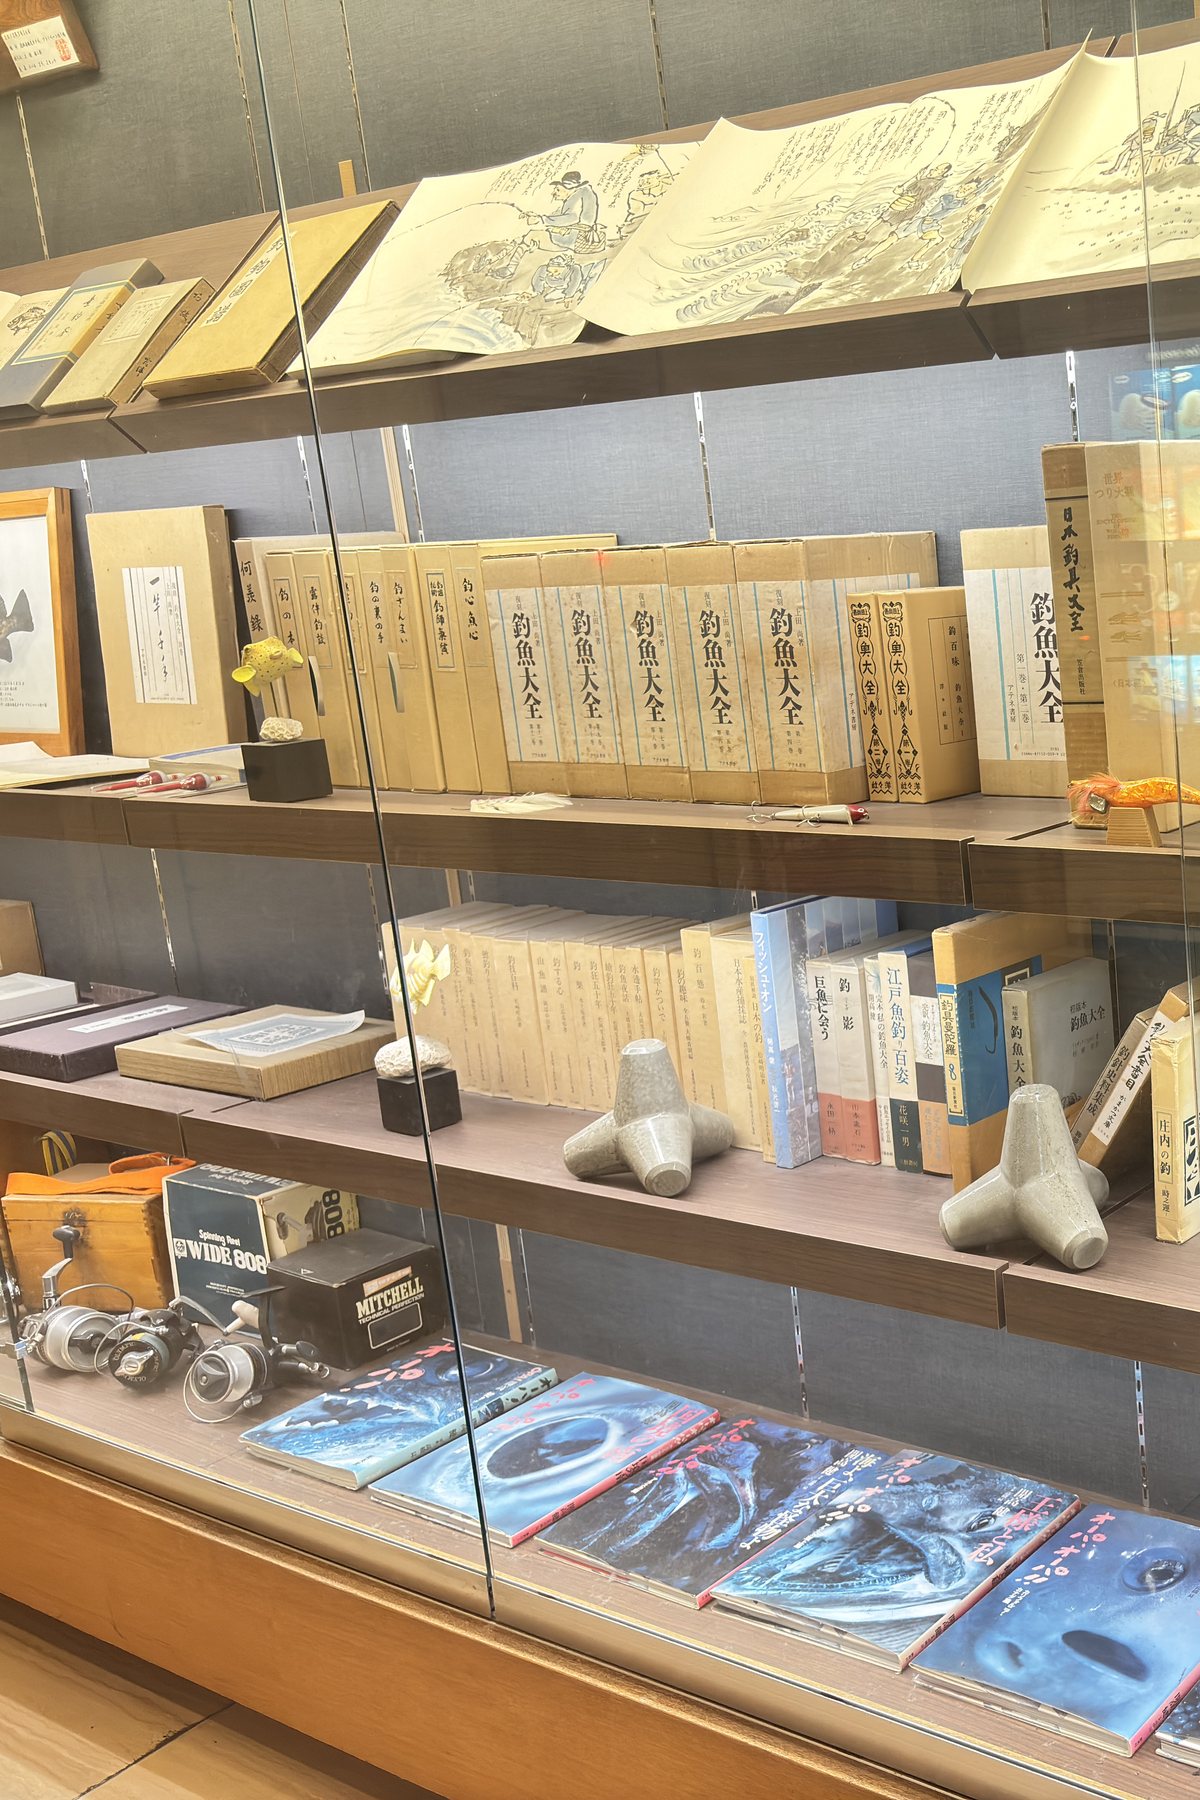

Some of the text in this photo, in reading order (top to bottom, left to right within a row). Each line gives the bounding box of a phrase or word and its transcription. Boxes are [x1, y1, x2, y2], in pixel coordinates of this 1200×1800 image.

[279, 588, 296, 643] 釣の本
[462, 578, 479, 641] 釣心魚心
[512, 612, 543, 719] 釣魚大全
[571, 609, 603, 719] 釣魚大全
[634, 610, 666, 722] 釣魚大全
[699, 609, 733, 725] 釣魚大全
[769, 607, 804, 725] 釣魚大全
[1017, 653, 1030, 724] 第一巻・第二巻
[1030, 592, 1063, 724] 釣魚大全
[1008, 684, 1017, 723] アテネ書房
[754, 932, 771, 1013] フィッシュ・オン
[752, 1002, 763, 1043] 日本の釣
[815, 976, 829, 1041] 巨魚に会う
[1070, 1006, 1106, 1032] 釣魚大全
[1010, 1025, 1026, 1087] 釣魚大全
[899, 1105, 910, 1148] 花咲一男
[1160, 1119, 1171, 1176] 庄内の釣
[199, 1230, 241, 1246] Spinning Reel
[322, 1189, 346, 1238] 808
[187, 1240, 267, 1274] WIDE 808
[356, 1277, 424, 1319] MITCHELL
[359, 1292, 424, 1324] TECHNICAL PERFECTION
[967, 1494, 1062, 1566] 王様と私
